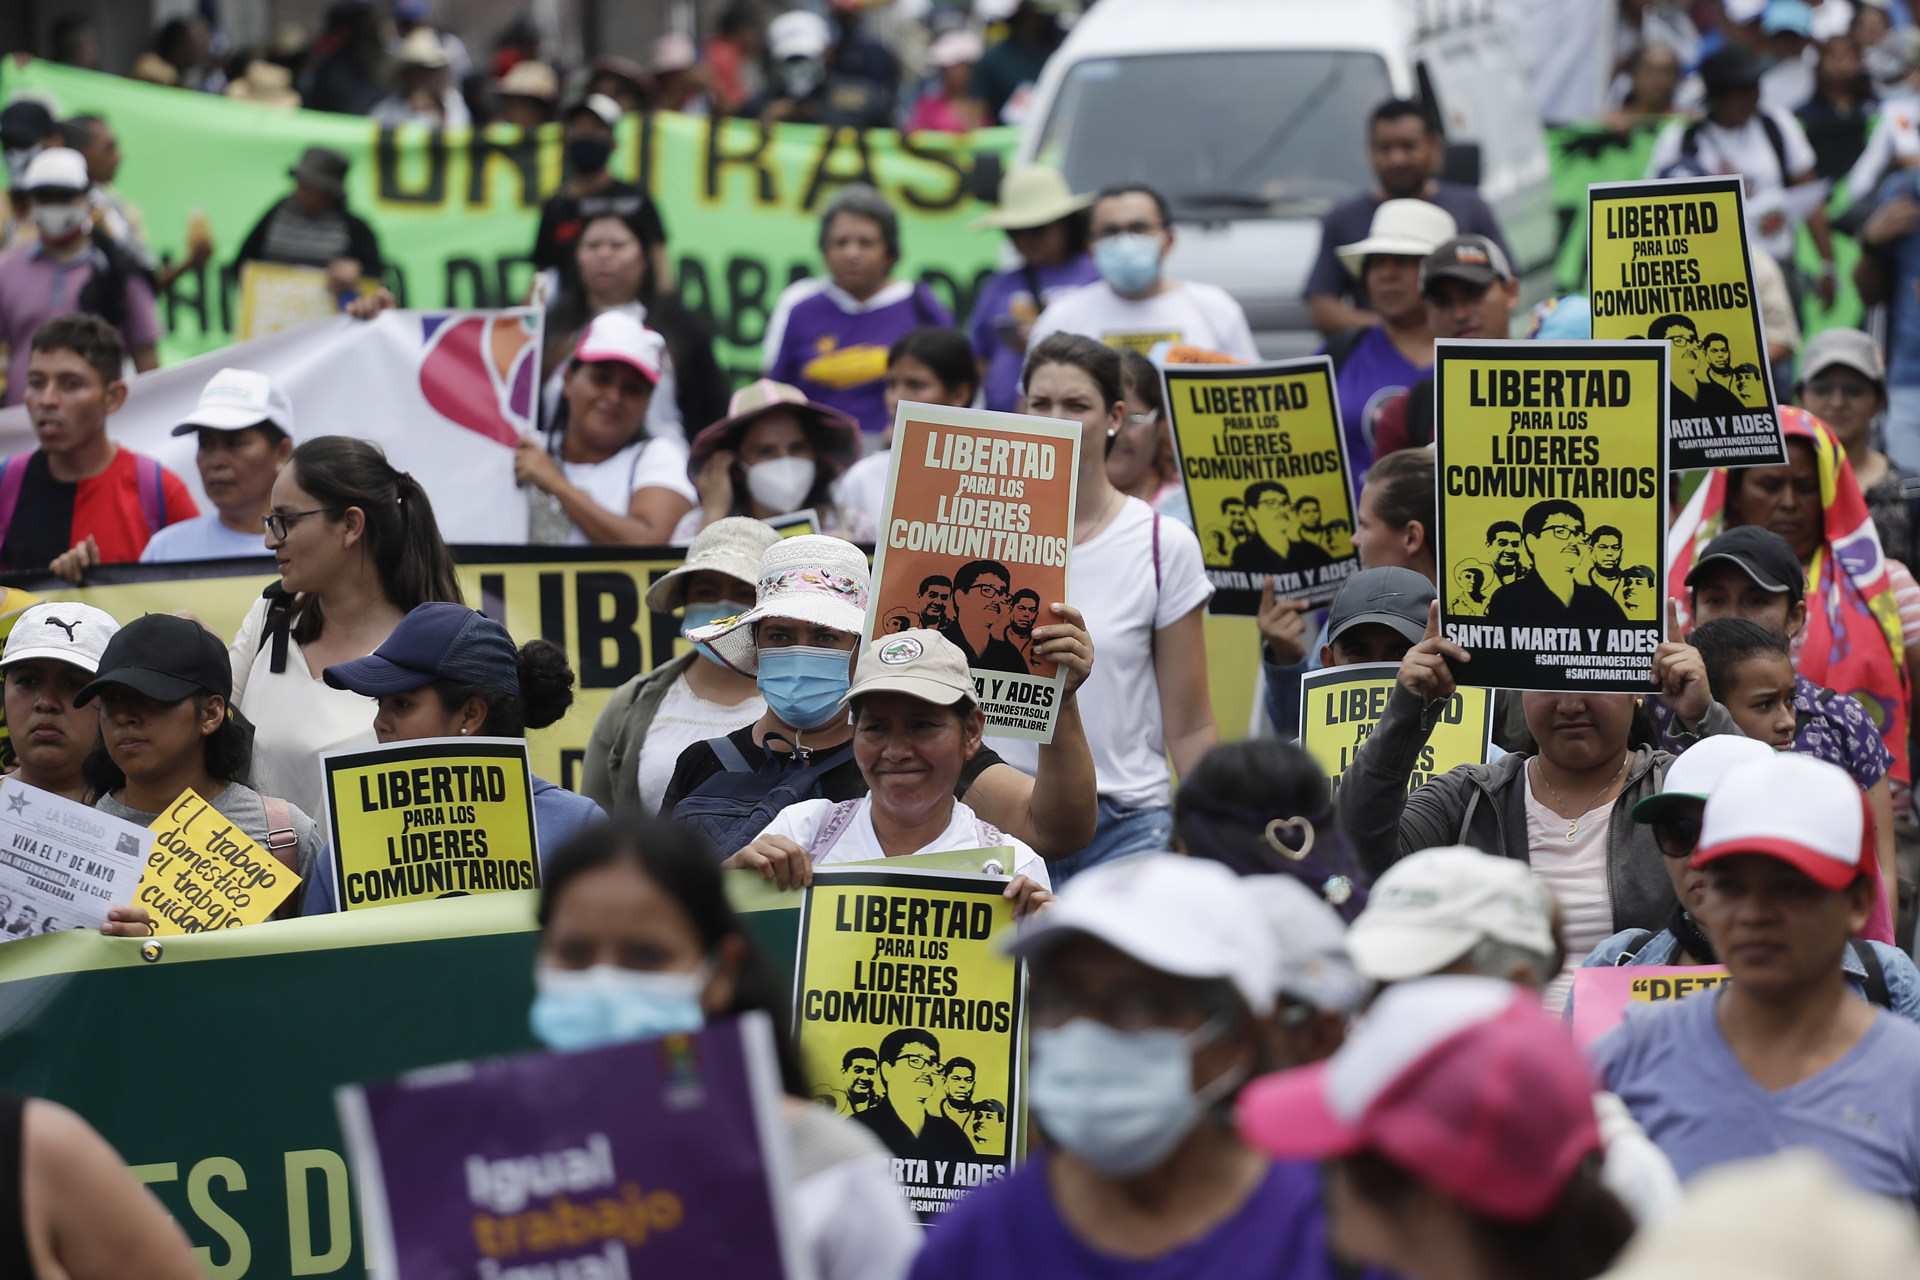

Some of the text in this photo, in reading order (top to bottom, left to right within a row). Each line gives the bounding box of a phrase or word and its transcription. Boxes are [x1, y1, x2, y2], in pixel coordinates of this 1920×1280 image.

[1607, 201, 1718, 239] LIBERTAD
[1633, 238, 1688, 257] PARA LOS
[1621, 255, 1700, 288] LÍDERES
[1594, 282, 1749, 317] COMUNITARIOS
[1190, 381, 1308, 414] LIBERTAD
[1470, 369, 1631, 407] LIBERTAD
[1223, 415, 1279, 430] PARA LOS
[1511, 411, 1588, 430] PARA LOS
[1669, 413, 1775, 439] ARTA Y ADES
[924, 431, 1056, 481] LIBERTAD
[1213, 430, 1292, 456] LÍDERES
[1492, 427, 1600, 465] LÍDERES
[1678, 435, 1778, 450] #SANTAMARTANOESTASOLA
[1704, 445, 1779, 458] #SANTAMARTALIBRE
[1186, 449, 1339, 480] COMUNITARIOS
[957, 475, 1024, 498] PARA LOS
[1447, 465, 1655, 498] COMUNITARIOS
[937, 490, 1031, 532] LÍDERES
[889, 519, 1066, 567] COMUNITARIOS
[1250, 572, 1302, 592] MRTA
[1303, 568, 1315, 585] Y
[1318, 558, 1358, 582] ADES
[1445, 623, 1659, 653] SANTA MARTA Y ADES
[1535, 654, 1653, 668] #SANTAMARTANOESTASOL
[1565, 669, 1652, 681] #SANTAMARTALIB
[992, 679, 1004, 700] Y
[1005, 681, 1055, 707] ADES
[360, 766, 506, 812] LIBERTAD
[45, 808, 60, 824] LA
[403, 805, 475, 827] PARA LOS
[12, 833, 37, 855] VIVA
[39, 843, 54, 860] EL
[69, 855, 85, 871] DE
[85, 860, 116, 883] MAYO
[171, 794, 277, 890] El trabajo
[387, 827, 488, 866] LÍDERES
[157, 827, 250, 908] doméstico
[347, 860, 533, 904] COMUNITARIOS
[26, 875, 75, 902] TRABAJADORA
[69, 878, 81, 889] DE
[80, 881, 89, 892] LA
[91, 885, 113, 901] CLASE
[148, 852, 244, 932] el trabajo
[836, 894, 992, 940] LIBERTAD
[875, 937, 949, 960] PARA LOS
[854, 953, 958, 996] LÍDERES
[804, 990, 1010, 1033] COMUNITARIOS
[935, 1160, 949, 1185] Y
[953, 1162, 1006, 1188] ADES
[473, 1181, 683, 1259] trabajo
